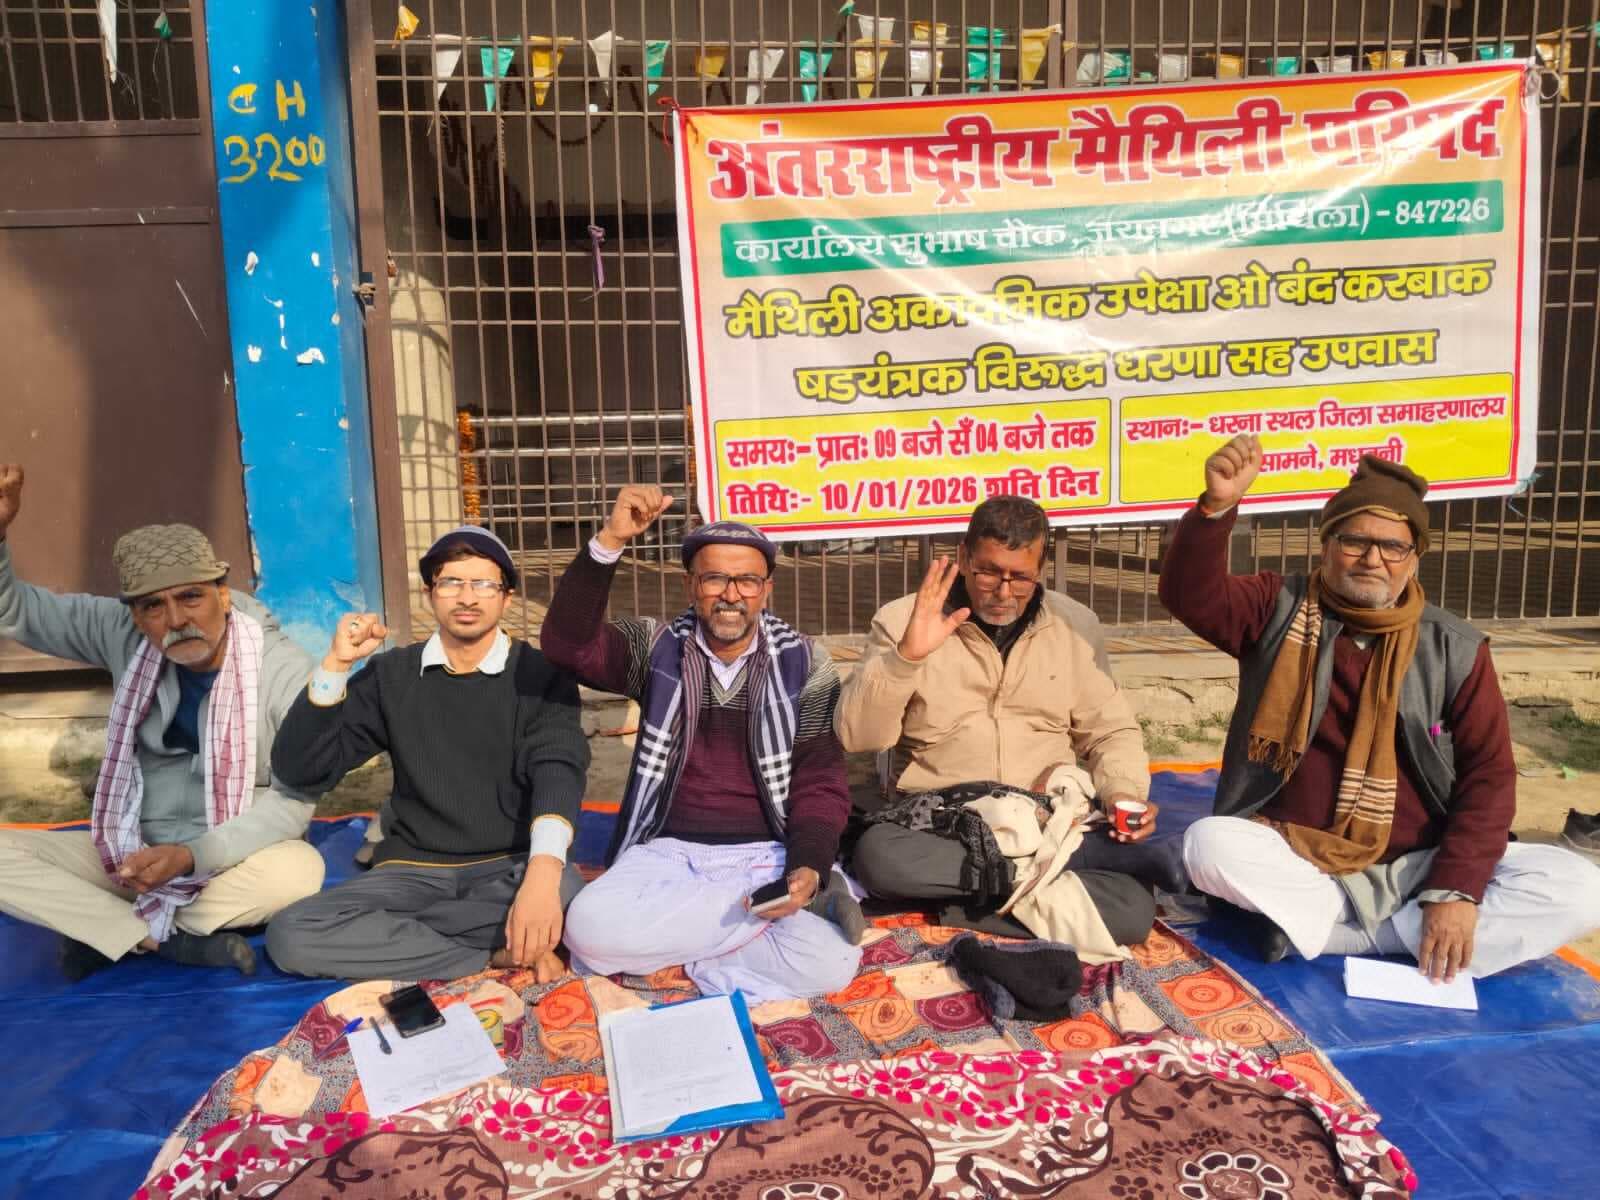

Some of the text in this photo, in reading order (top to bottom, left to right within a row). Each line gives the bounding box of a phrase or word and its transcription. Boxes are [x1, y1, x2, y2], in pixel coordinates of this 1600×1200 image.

[219, 132, 325, 183] 3200
[706, 114, 1062, 206] अंतरराष्ट्रीय
[1069, 98, 1294, 183] मैथिली
[889, 229, 989, 265] सुभाष
[723, 284, 864, 339] मैथिली
[1096, 266, 1210, 317] उपेक्षा
[1214, 260, 1271, 310] ओ
[1276, 258, 1339, 306] बंद
[1342, 259, 1496, 301] करबाक
[793, 351, 967, 404] षडयंत्रक
[1112, 341, 1227, 383] धरणा
[1228, 338, 1297, 379] सह
[1300, 329, 1439, 371] उपवास
[874, 430, 897, 458] 09
[902, 420, 944, 460] बजे
[976, 424, 998, 452] 04
[1003, 415, 1046, 450] बजे
[1051, 420, 1096, 448] तक
[1209, 413, 1263, 434] धरना
[1266, 410, 1315, 431] स्थल
[1319, 401, 1372, 427] जिला
[1377, 397, 1506, 424] समाहरणालय
[983, 469, 1041, 498] शनि
[1047, 466, 1099, 497] दिन
